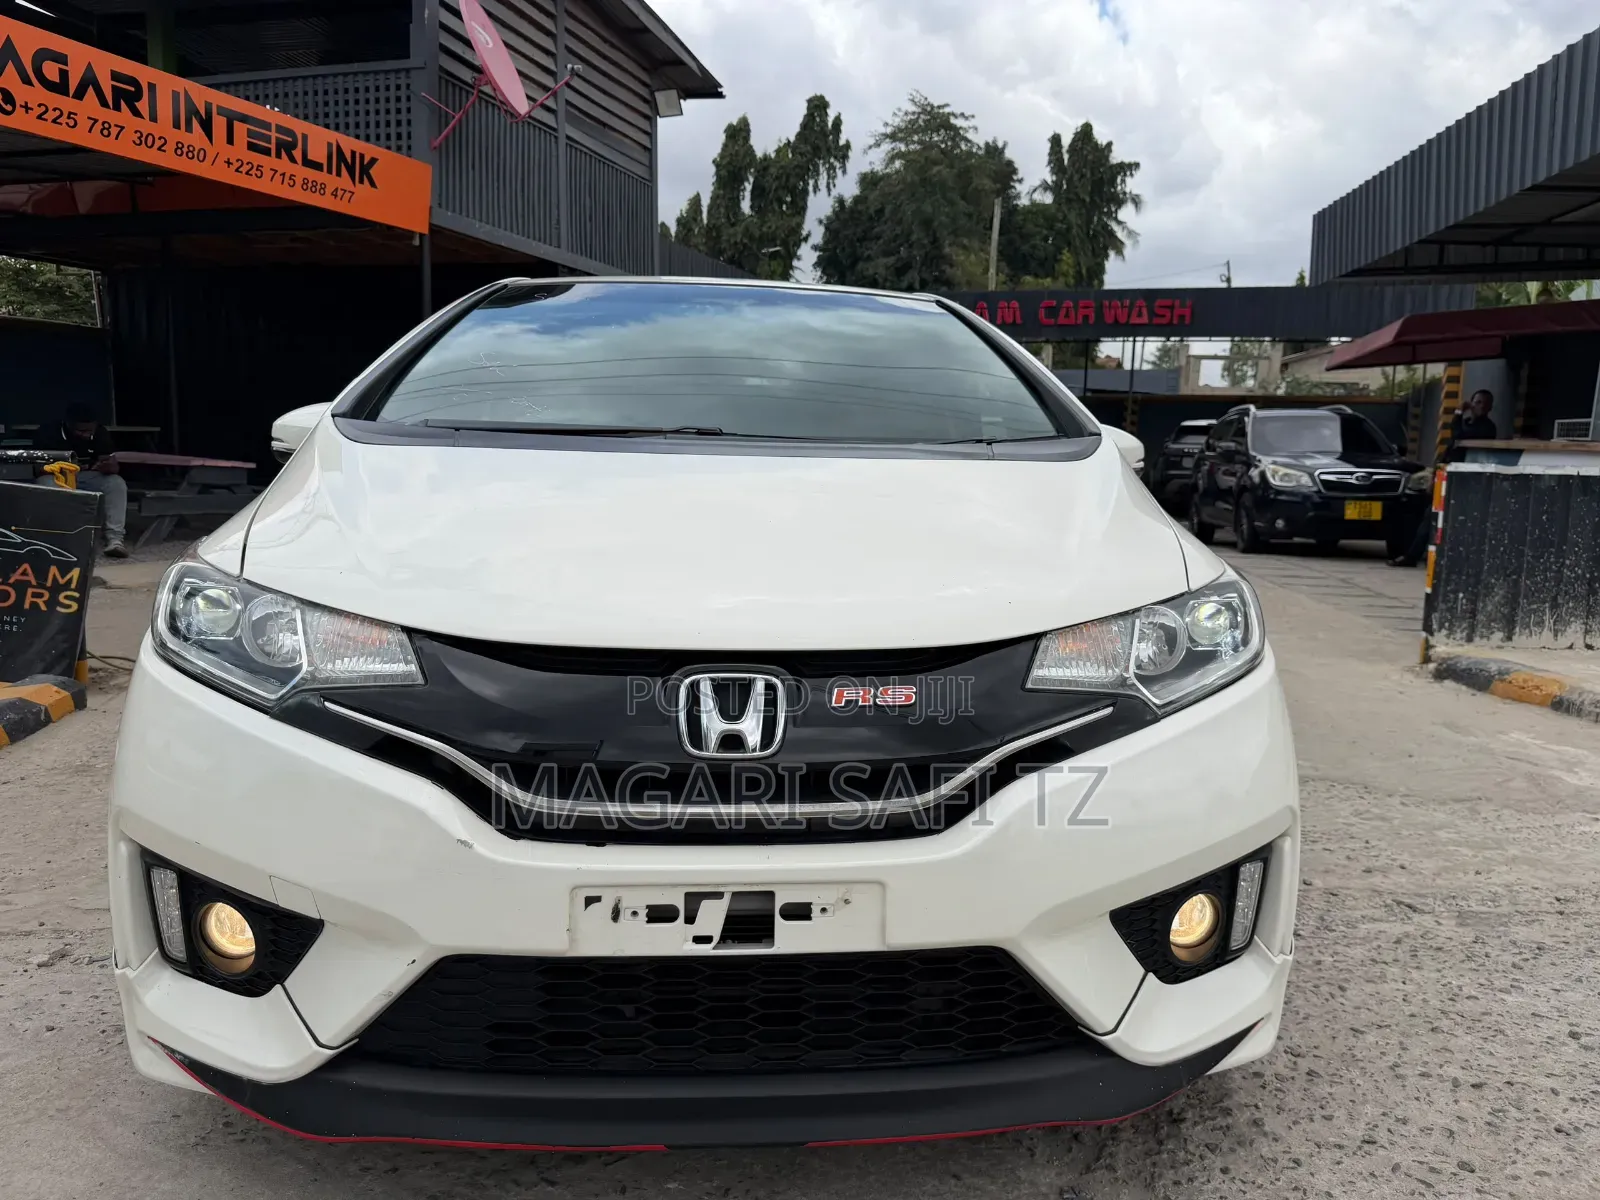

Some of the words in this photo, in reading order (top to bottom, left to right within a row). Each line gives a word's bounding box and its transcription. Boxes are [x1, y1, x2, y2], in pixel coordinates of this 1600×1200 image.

[171, 87, 380, 189] INTERLINK
[19, 101, 78, 129] +225
[86, 116, 126, 141] 787
[131, 130, 168, 153] 302
[173, 139, 207, 164] 880
[223, 157, 264, 179] +225
[269, 168, 296, 188] 715
[301, 178, 327, 197] 888
[330, 187, 355, 203] 477
[1038, 300, 1096, 325] CAR
[1102, 299, 1192, 325] WASH
[0, 562, 81, 589] AM
[830, 685, 918, 708] RS
